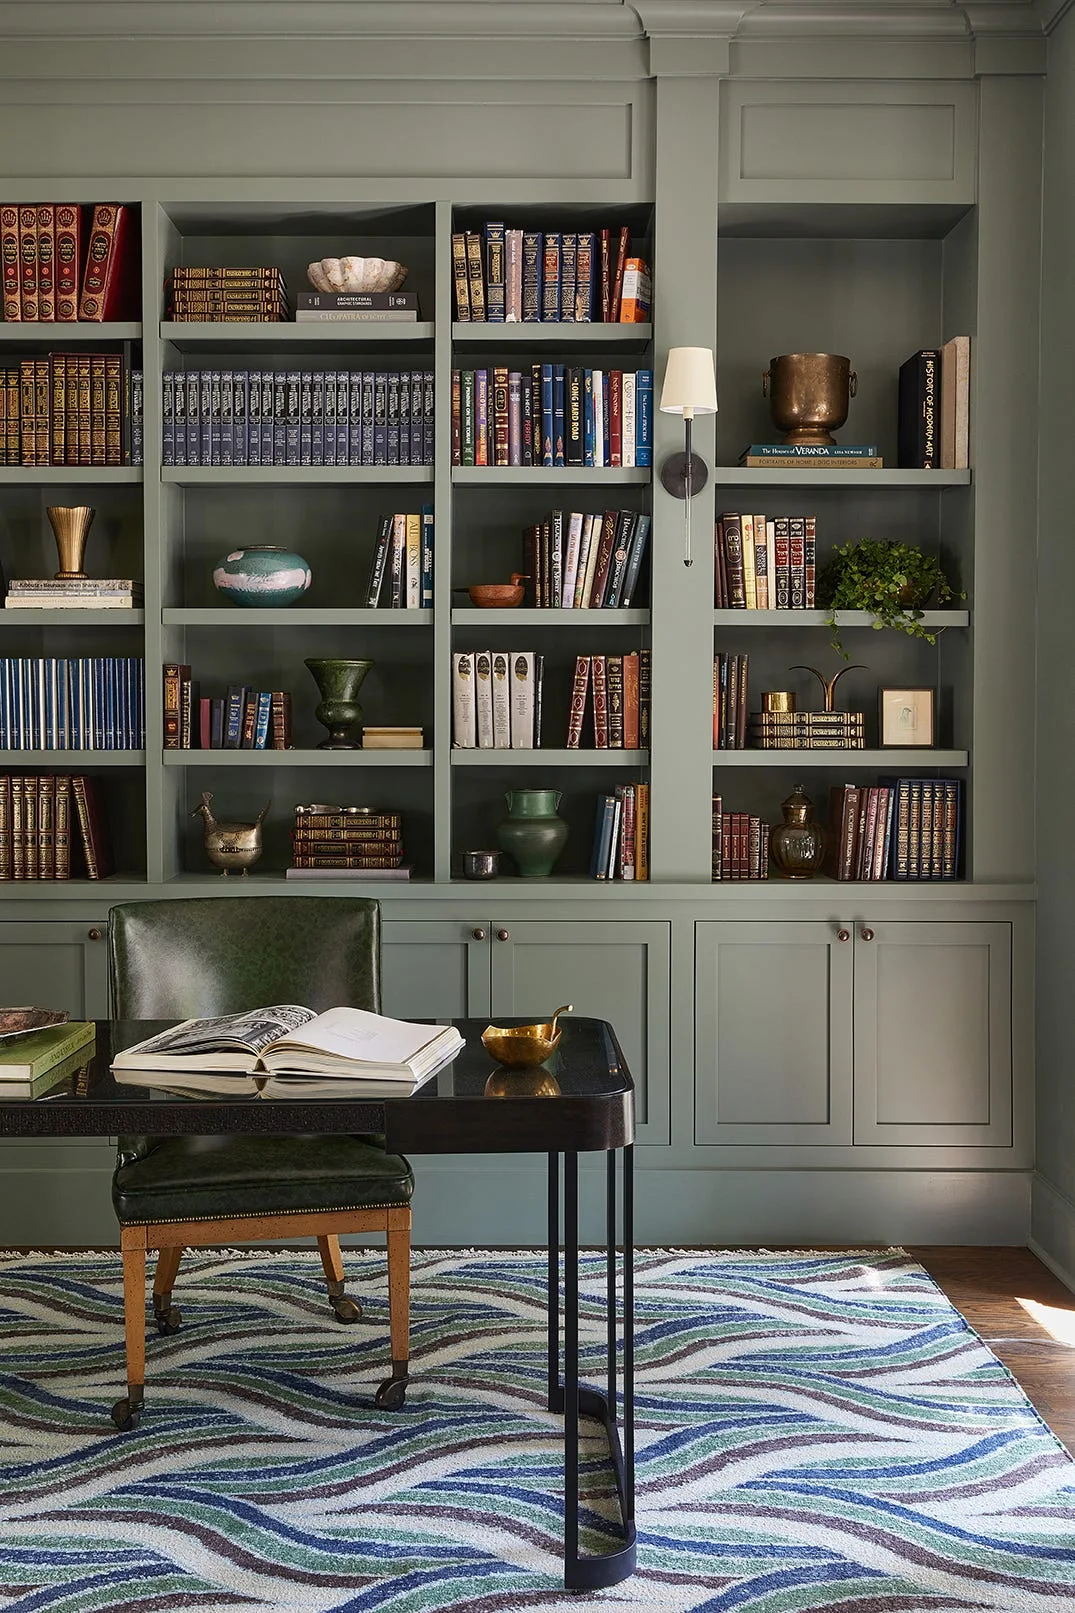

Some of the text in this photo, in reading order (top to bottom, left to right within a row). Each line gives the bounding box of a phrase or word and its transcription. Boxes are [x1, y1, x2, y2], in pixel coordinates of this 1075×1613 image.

[926, 360, 934, 394] HISTORY
[927, 396, 933, 405] OF
[795, 446, 829, 455] VERANDA
[409, 521, 418, 536] ALL
[635, 537, 644, 554] MEANT
[409, 545, 418, 567] BOSS
